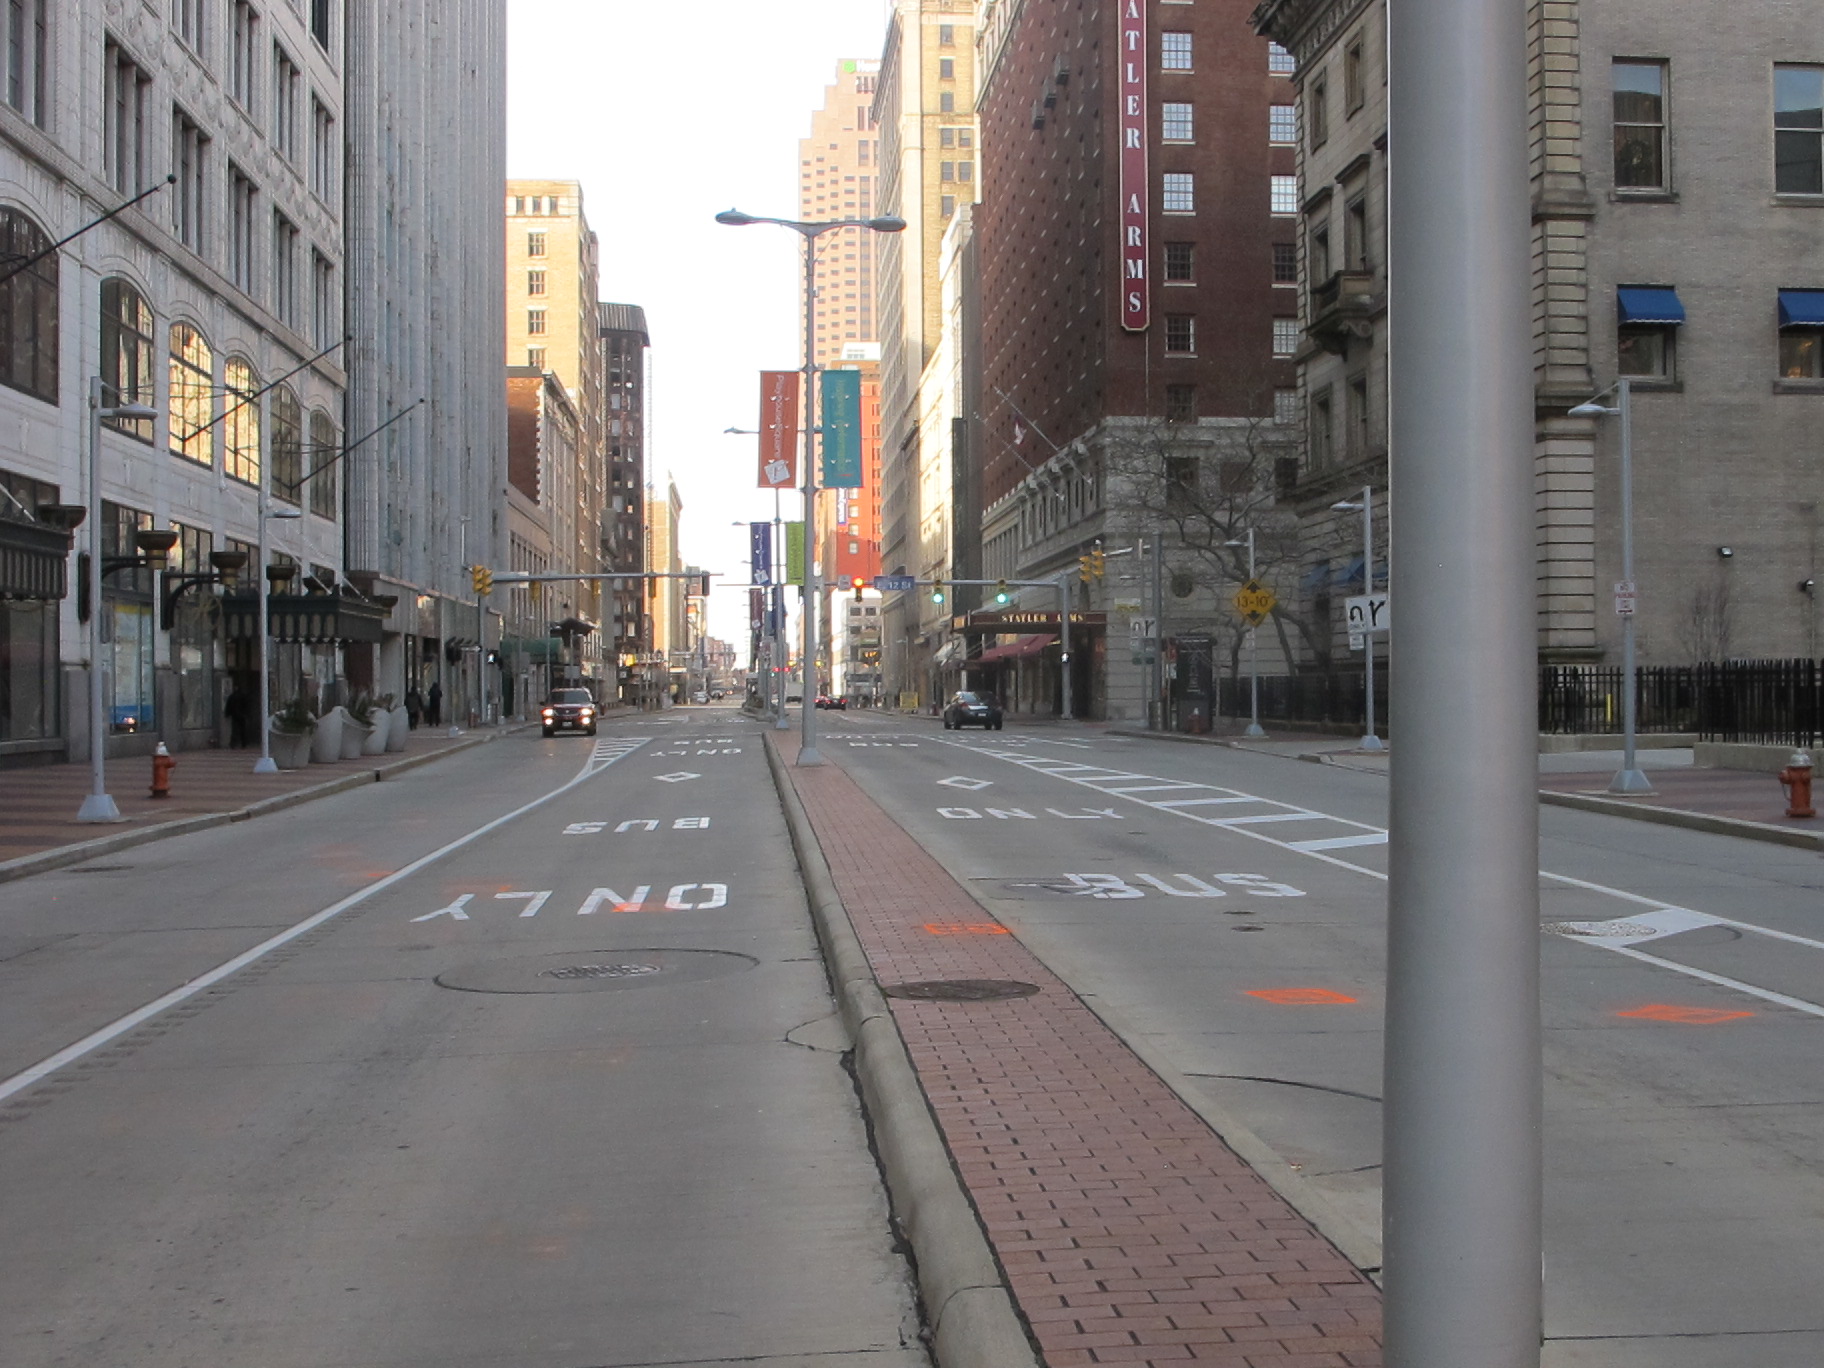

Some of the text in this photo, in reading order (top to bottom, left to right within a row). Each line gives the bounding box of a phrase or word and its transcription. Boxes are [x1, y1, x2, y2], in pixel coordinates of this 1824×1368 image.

[1126, 193, 1144, 313] ARMS
[888, 581, 899, 590] 12
[1001, 613, 1084, 622] STATLER AMS
[936, 807, 1125, 819] ONLY
[562, 817, 710, 835] BUS
[1063, 873, 1307, 899] BUS
[410, 883, 729, 922] ONLY
